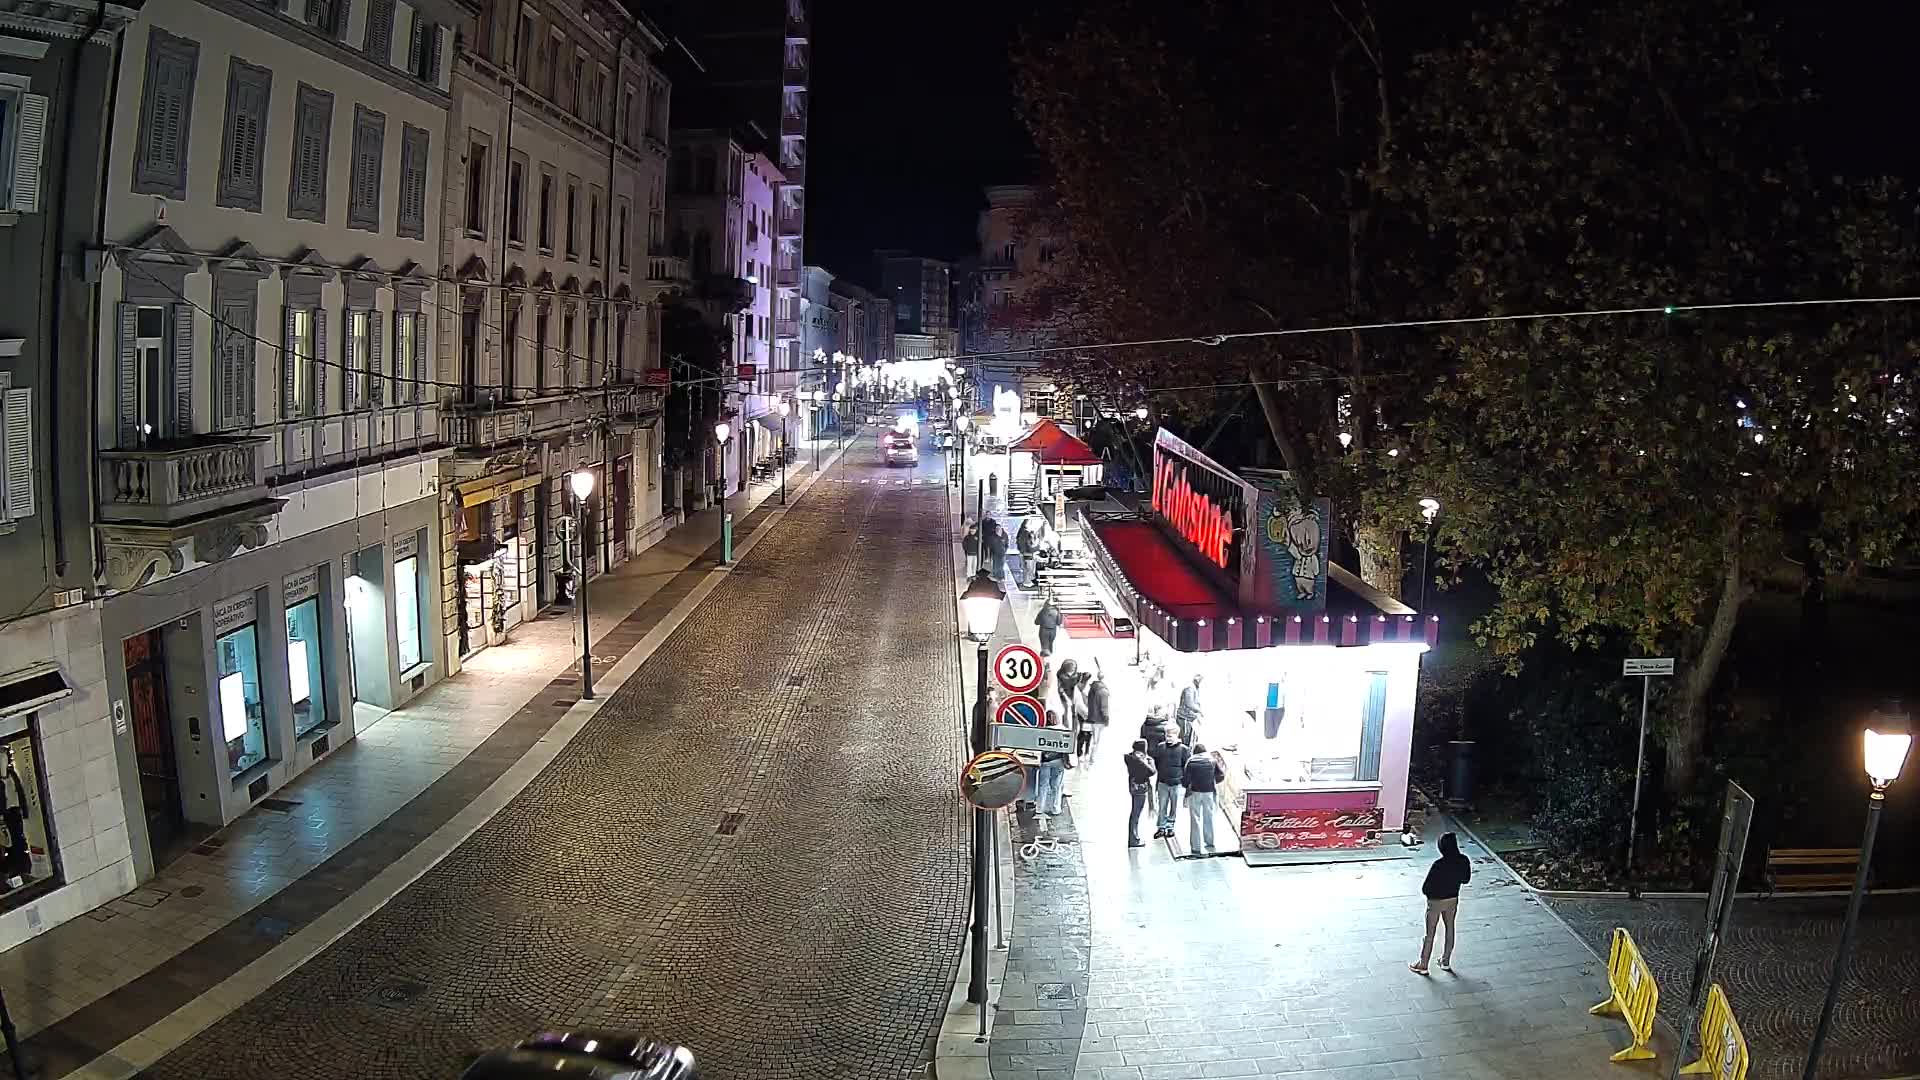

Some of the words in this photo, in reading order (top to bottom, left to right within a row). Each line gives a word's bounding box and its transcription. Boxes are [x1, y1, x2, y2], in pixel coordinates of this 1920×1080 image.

[1162, 458, 1233, 569] Golosone
[233, 596, 254, 611] CREDITO
[1006, 657, 1033, 680] 30
[1038, 737, 1069, 749] Dante
[1324, 814, 1376, 828] Calde
